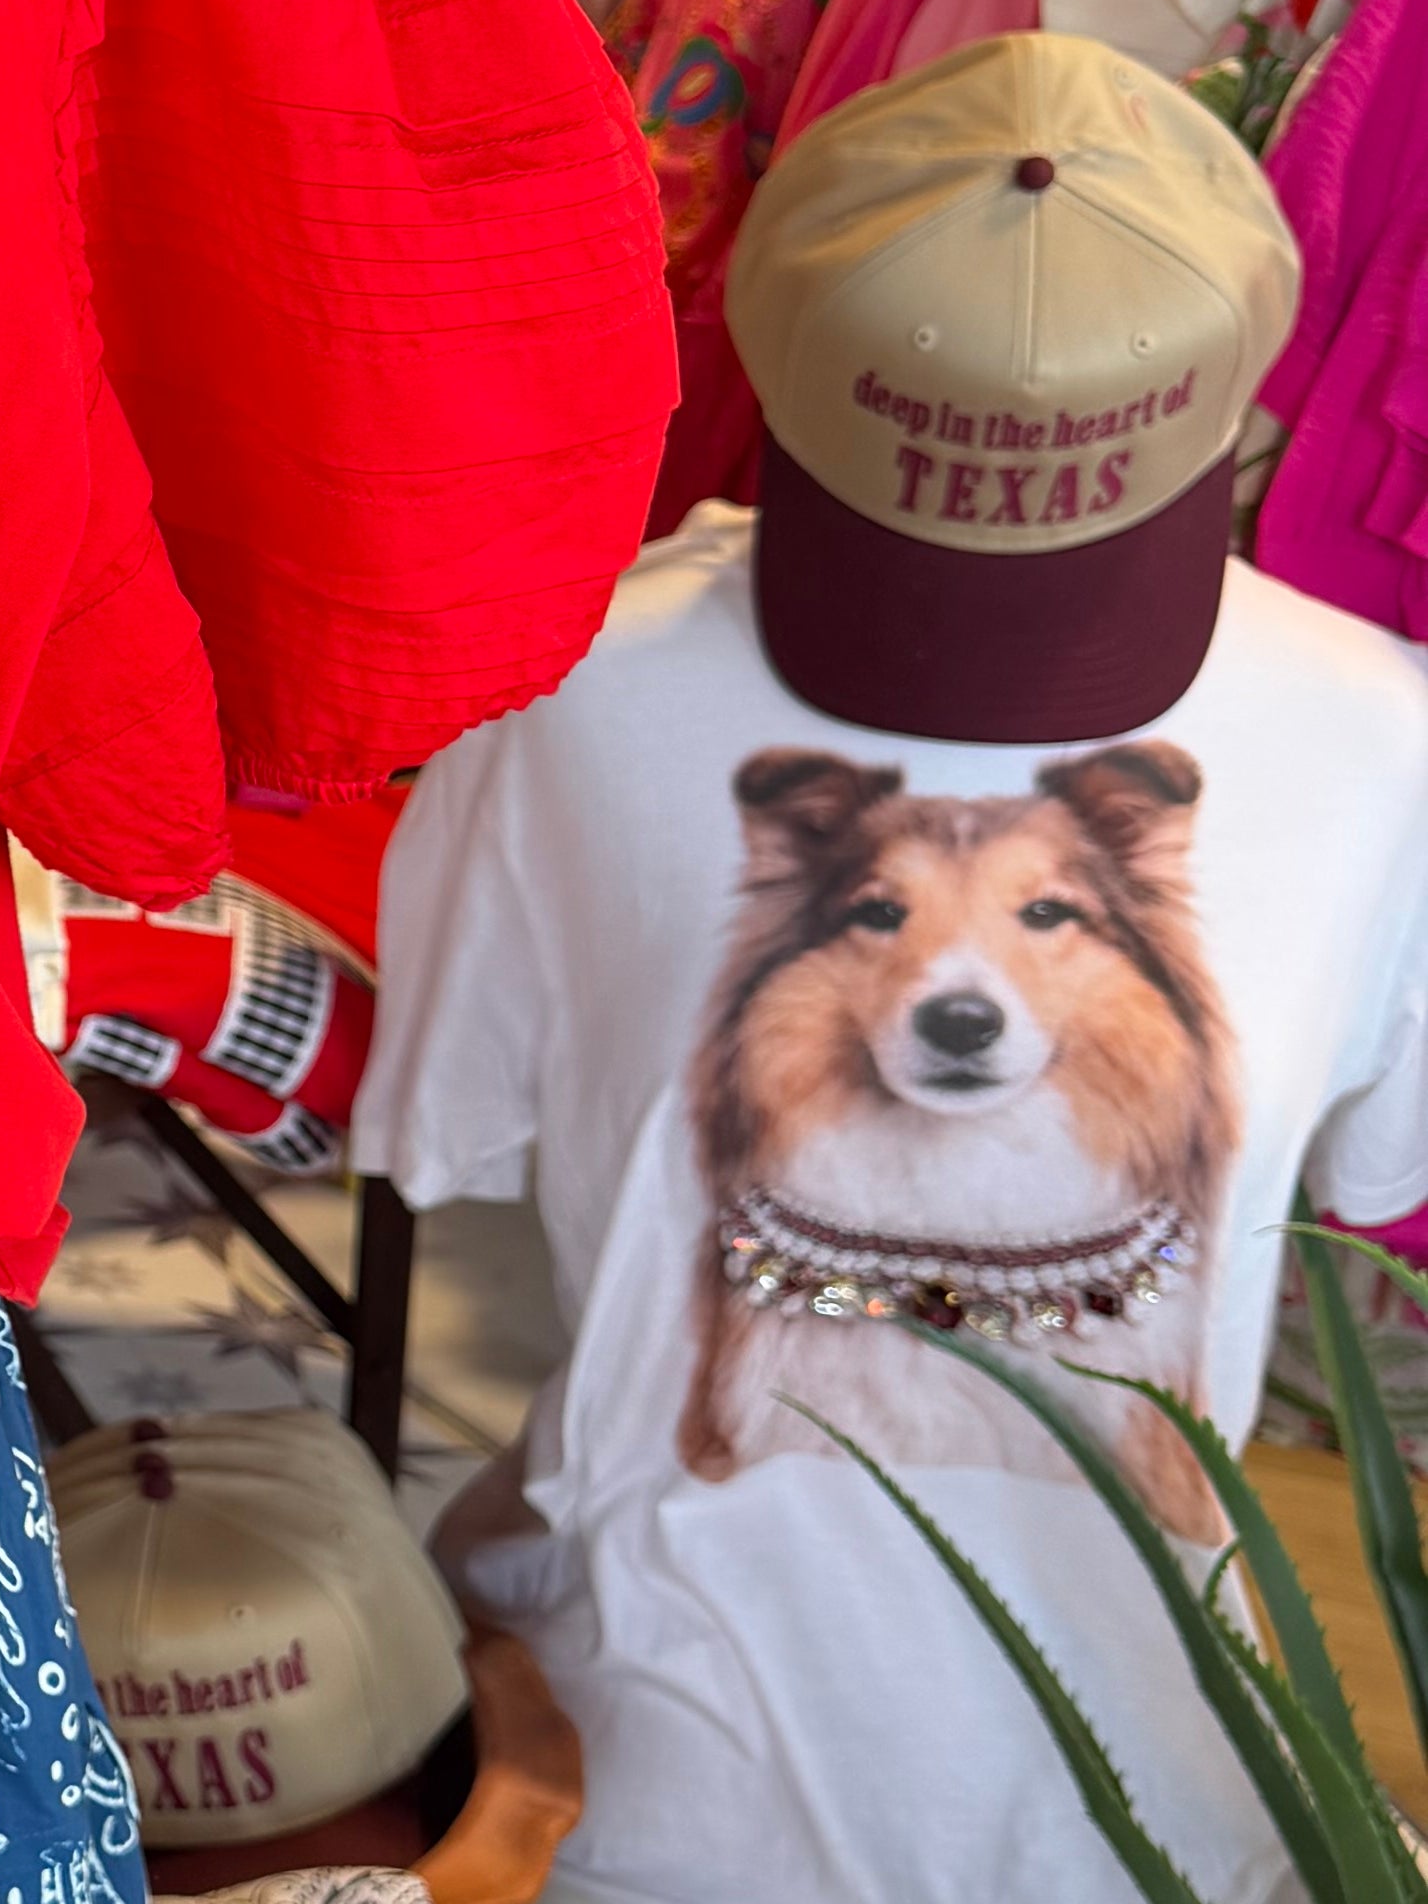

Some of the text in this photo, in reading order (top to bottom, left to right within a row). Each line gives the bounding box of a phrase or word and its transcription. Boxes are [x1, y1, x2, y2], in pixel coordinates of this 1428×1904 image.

[853, 367, 1198, 451] deep in the heart of
[895, 445, 1134, 527] TEXAS
[112, 1670, 169, 1718] the
[171, 1656, 273, 1715] heart
[277, 1637, 310, 1692] of
[120, 1727, 275, 1811] XAS
